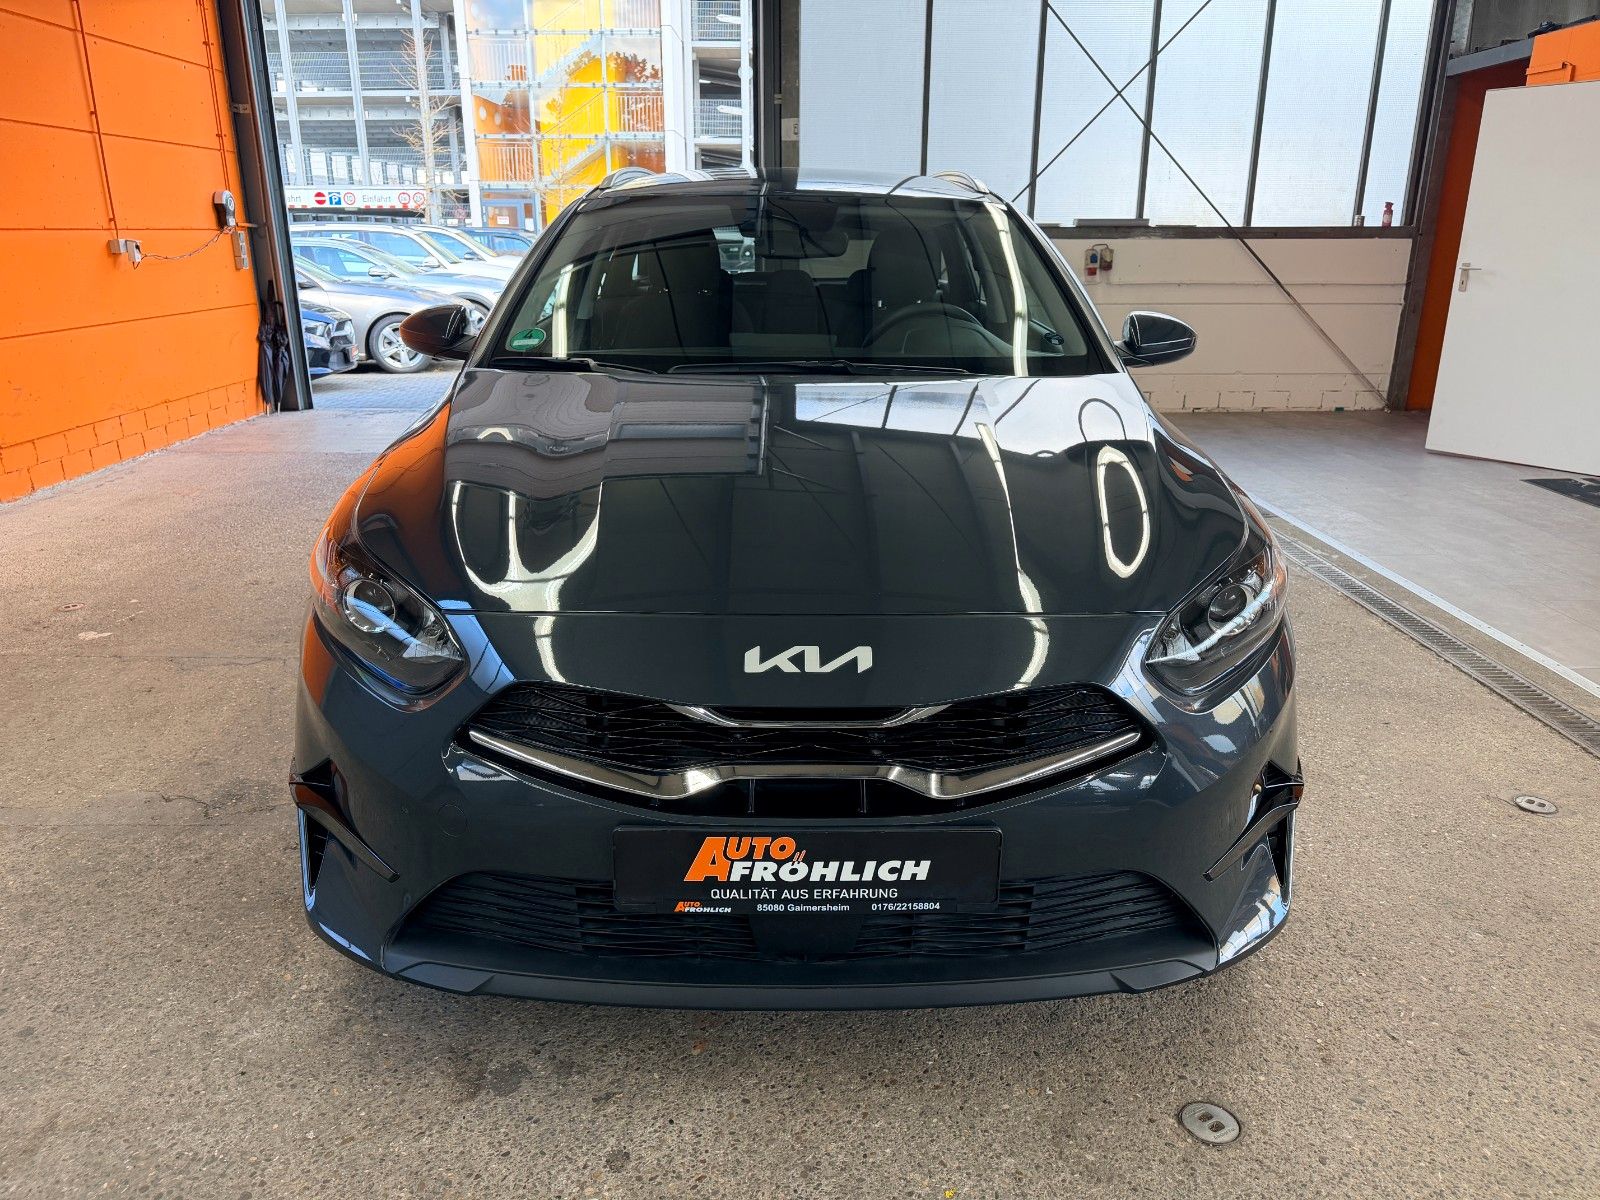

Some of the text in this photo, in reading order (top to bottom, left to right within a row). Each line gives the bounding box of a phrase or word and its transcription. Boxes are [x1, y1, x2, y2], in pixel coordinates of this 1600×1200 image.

[362, 194, 392, 203] Einfahrt
[523, 329, 534, 339] 4
[744, 645, 873, 674] KIA
[683, 836, 797, 882] AUTO
[729, 850, 932, 882] FRÖHLICH
[710, 887, 898, 900] QUALITÄT AUS ERFAHRUNG
[674, 901, 701, 913] AUTO
[756, 902, 940, 912] 85080 Gaimersheim 0176/22158804
